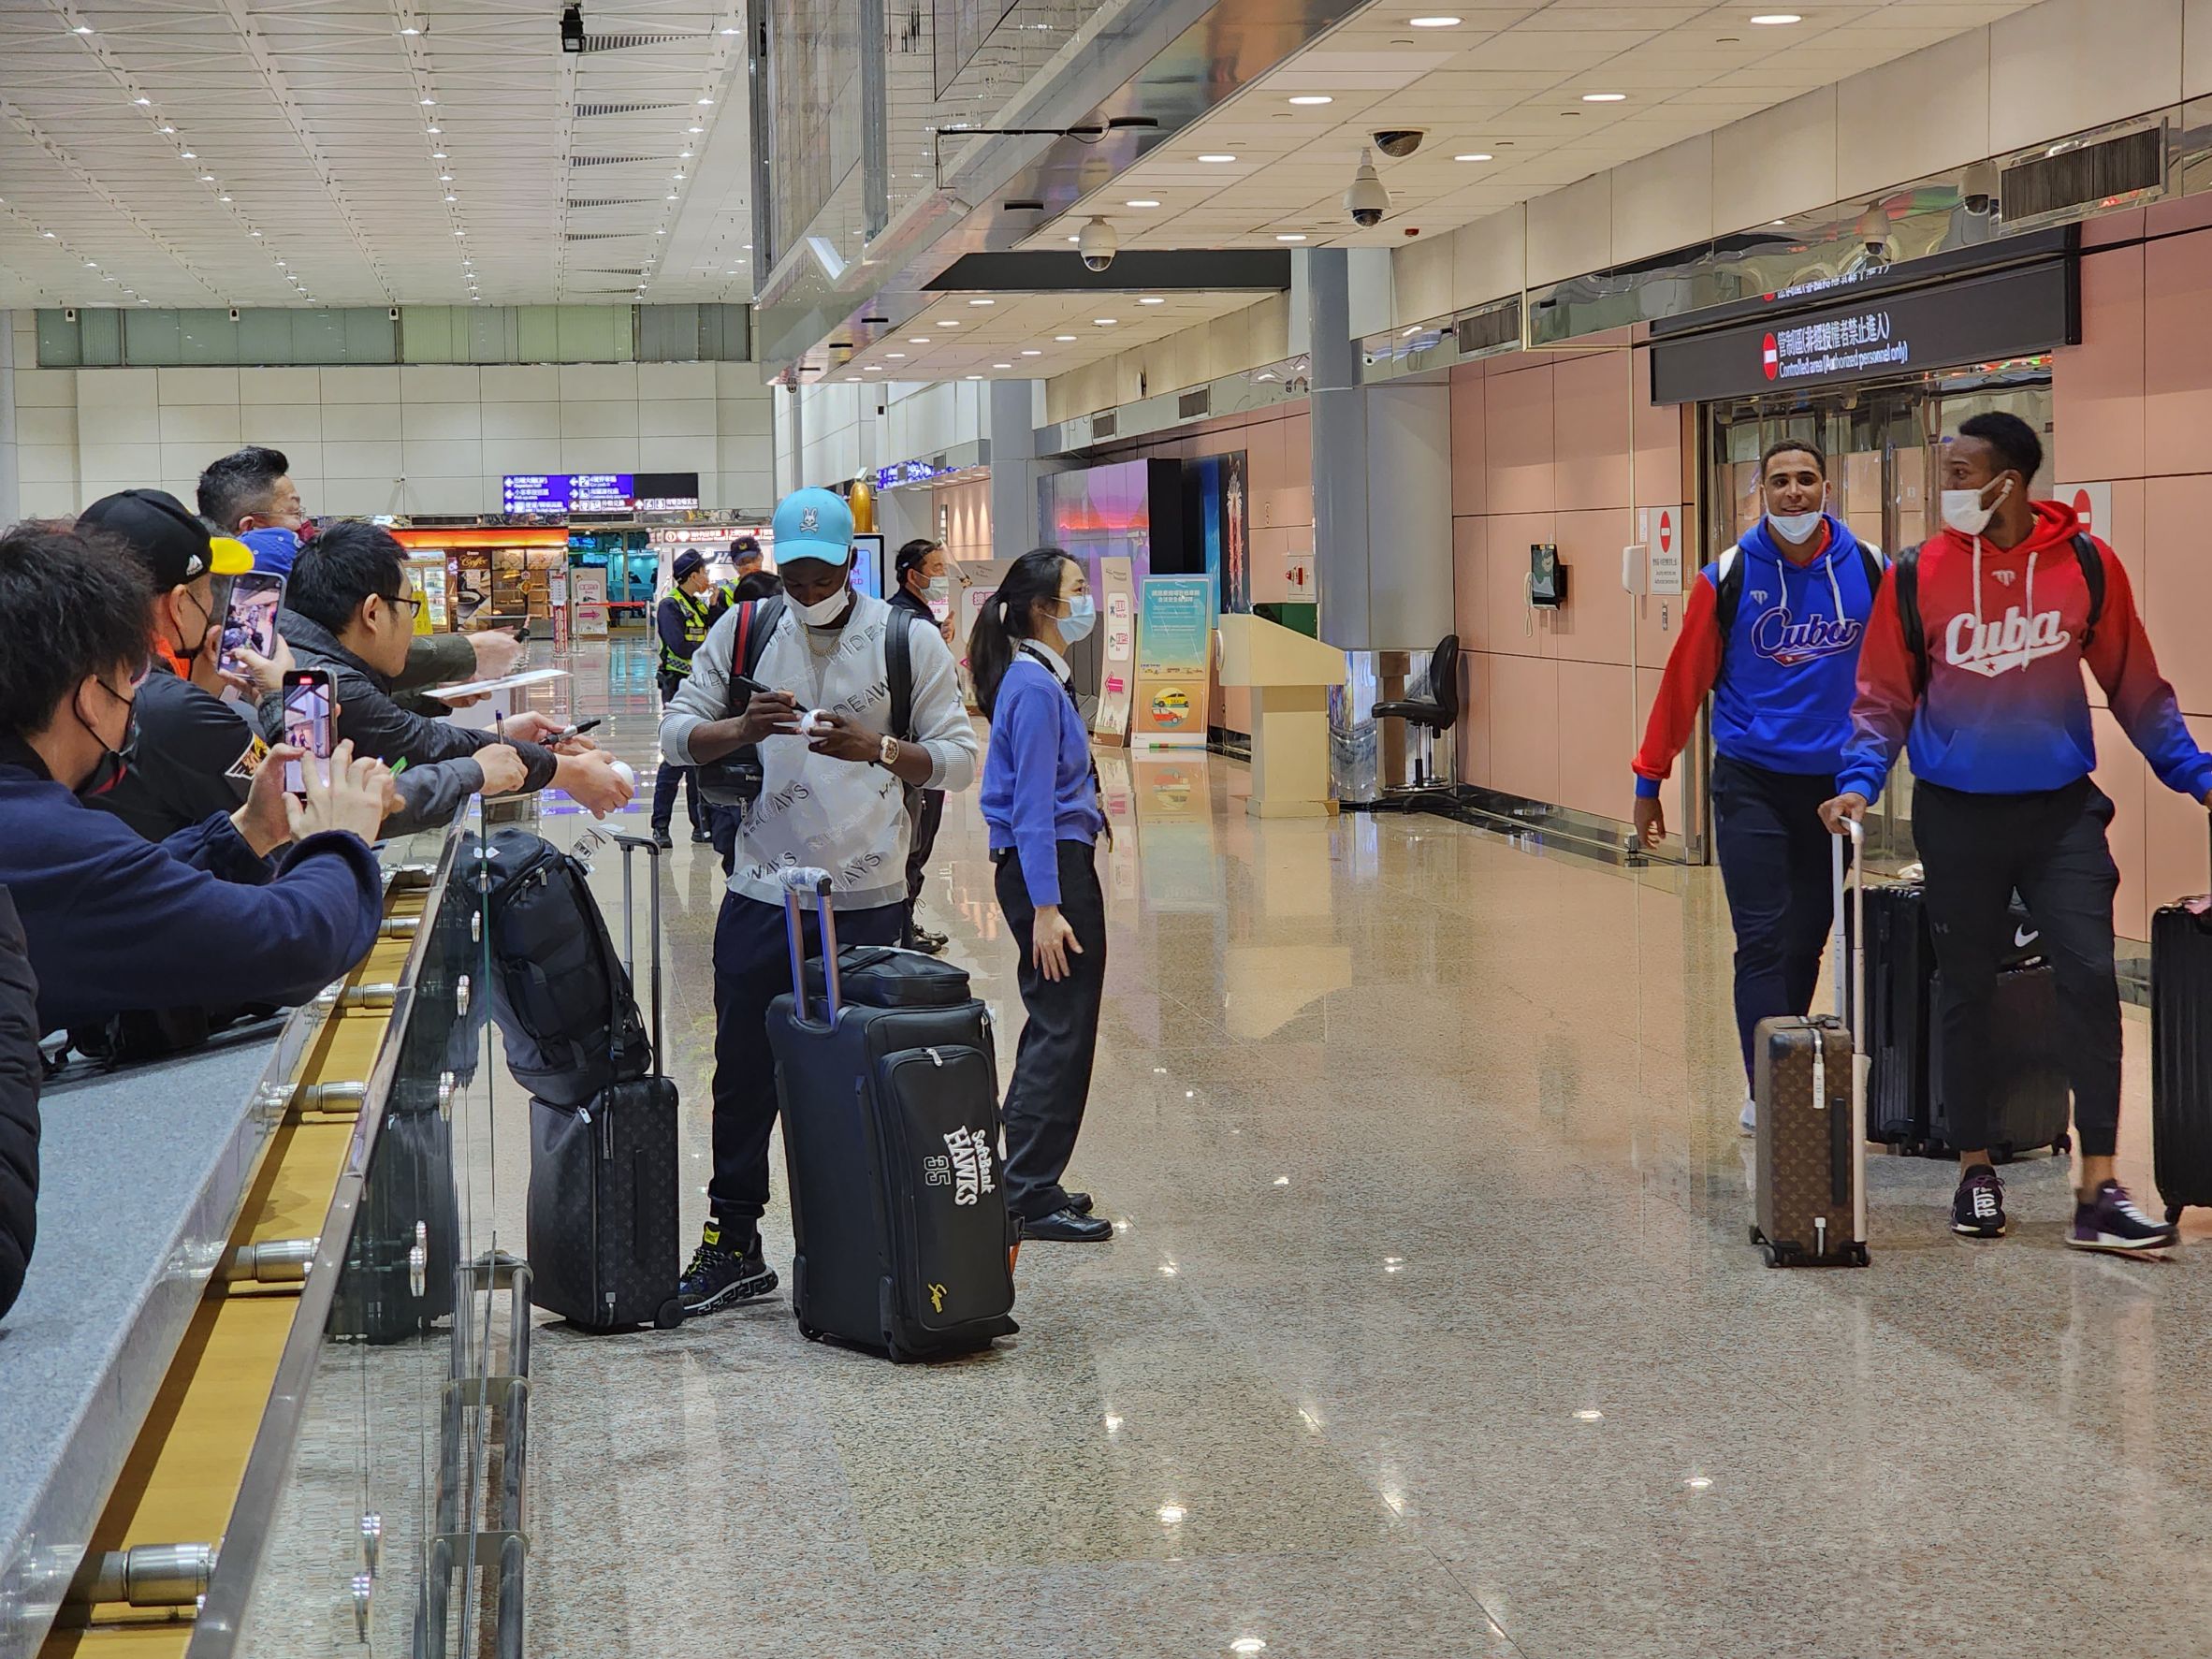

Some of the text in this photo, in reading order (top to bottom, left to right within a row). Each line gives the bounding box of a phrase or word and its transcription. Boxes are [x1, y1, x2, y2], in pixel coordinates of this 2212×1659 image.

[1780, 357, 1810, 378] Controlled
[1810, 359, 1824, 373] area
[1858, 342, 1891, 371] personnel
[1890, 341, 1908, 365] only)
[1753, 606, 1862, 660] Cuba
[1945, 606, 2070, 667] Cuba
[943, 1125, 978, 1206] HAWKS
[971, 1128, 996, 1194] SoftBank
